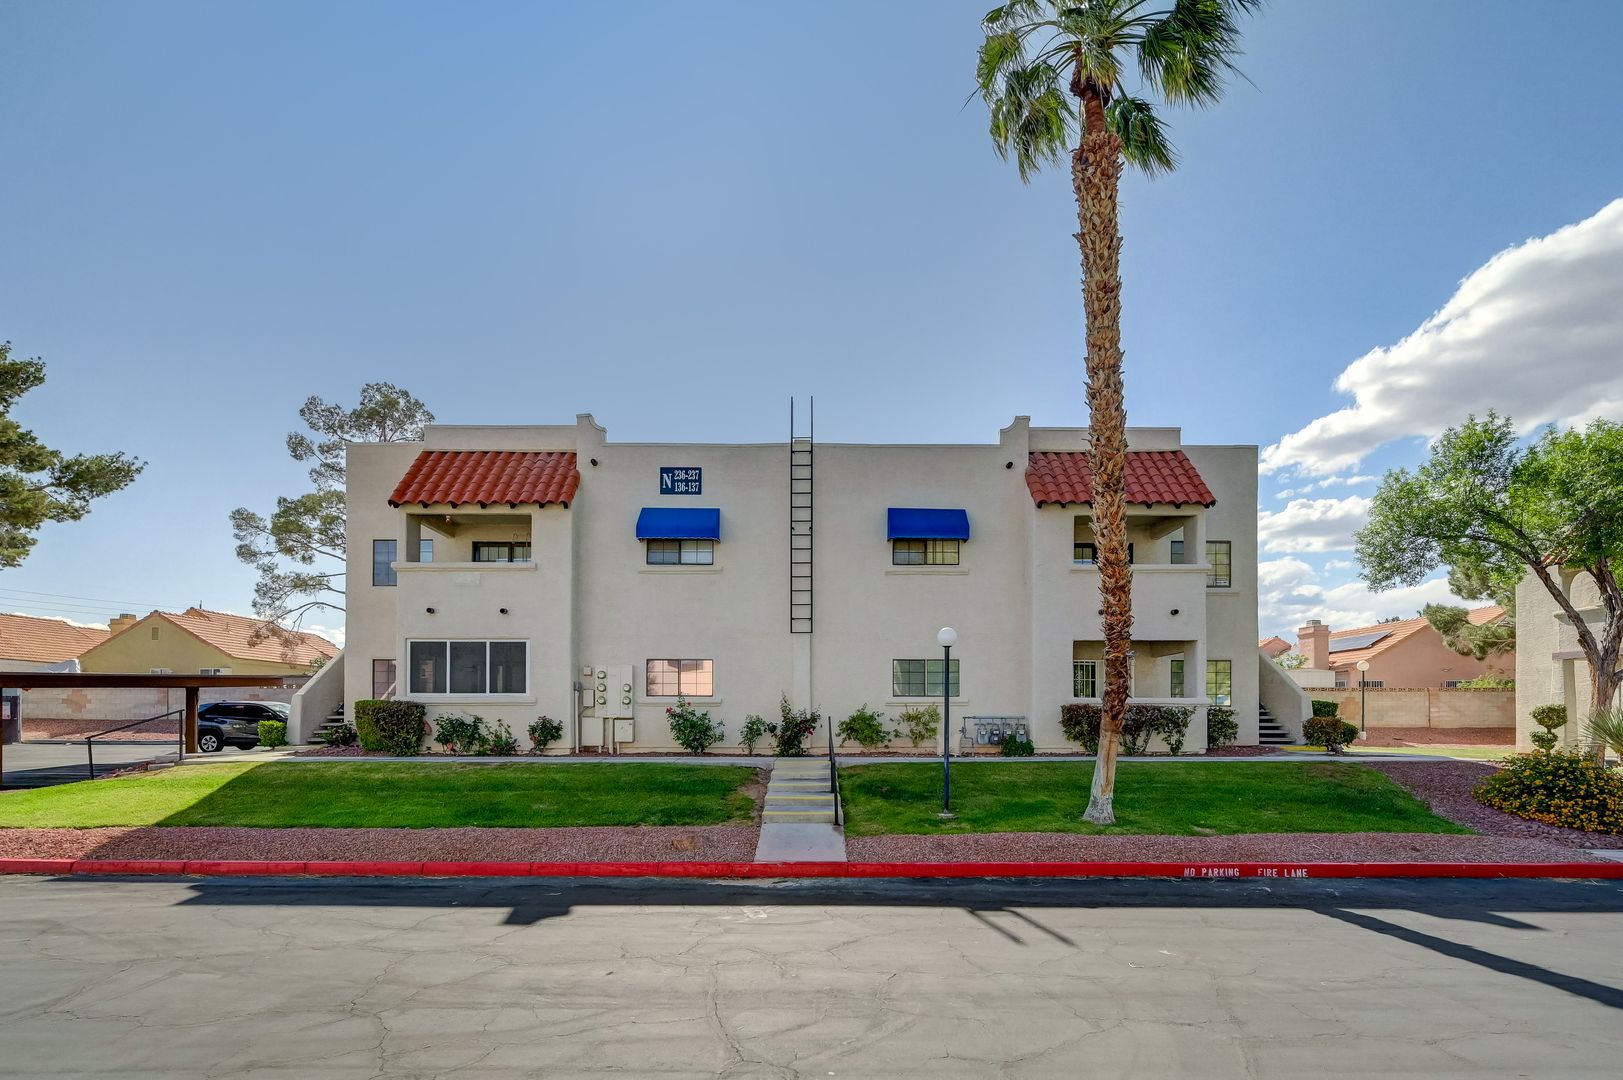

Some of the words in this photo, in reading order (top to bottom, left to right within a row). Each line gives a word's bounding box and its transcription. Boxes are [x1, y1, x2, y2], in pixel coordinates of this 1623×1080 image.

[674, 470, 699, 480] 236-237
[662, 473, 672, 488] N
[675, 482, 699, 492] 136-137
[1184, 868, 1195, 876] NO
[1201, 868, 1239, 876] PARKING
[1258, 868, 1278, 877] FIRE
[1284, 869, 1308, 877] LANE
